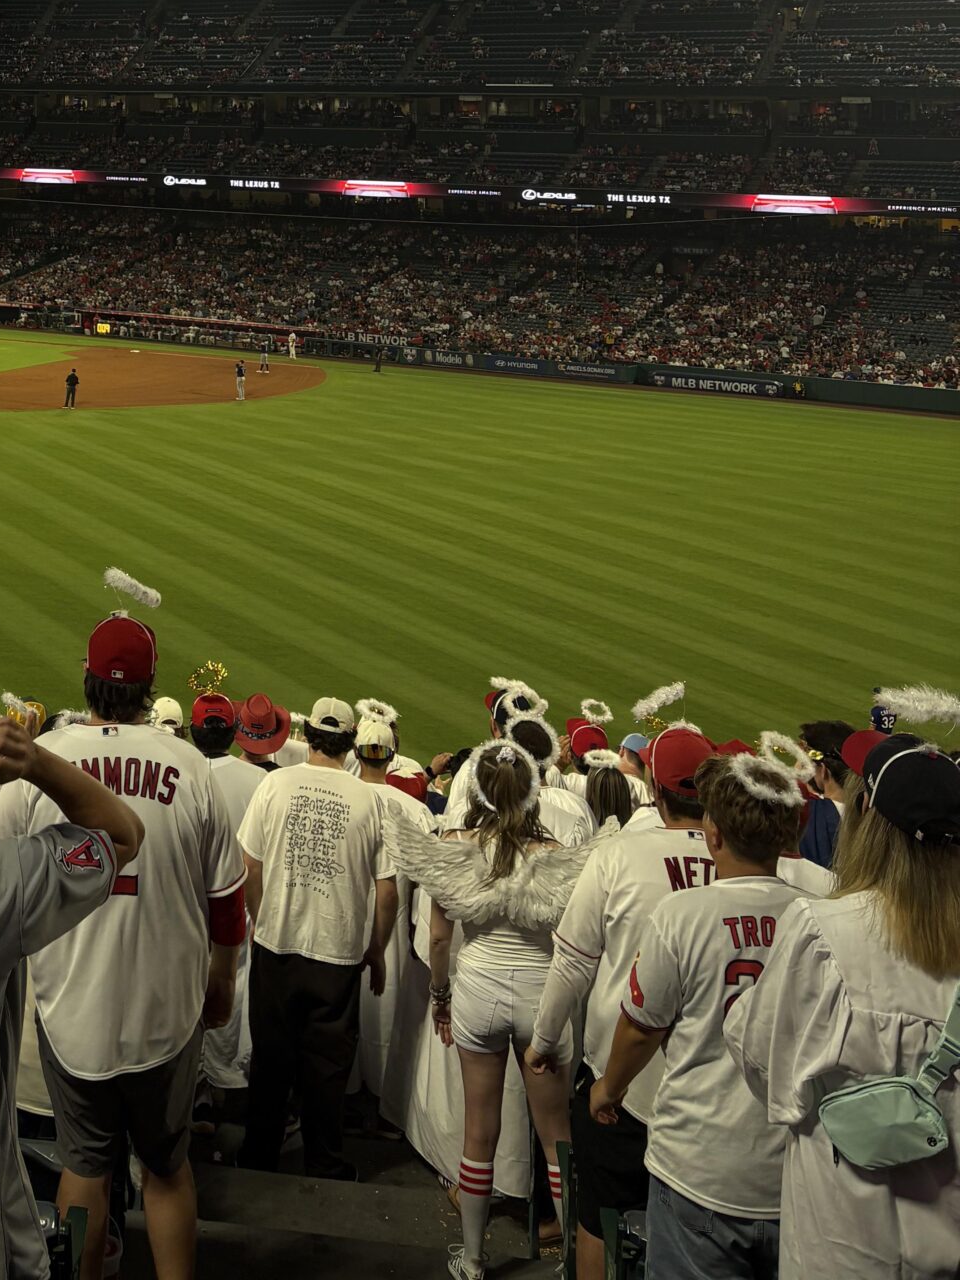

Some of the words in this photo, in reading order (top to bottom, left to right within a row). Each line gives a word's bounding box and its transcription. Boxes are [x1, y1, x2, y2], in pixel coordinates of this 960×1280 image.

[175, 178, 207, 186] LEXUS
[230, 179, 244, 188] THE
[244, 180, 269, 189] LEXUS
[270, 181, 280, 189] TX
[536, 191, 577, 200] LEXUS
[606, 193, 625, 202] THE
[626, 194, 657, 203] LEXUS
[658, 195, 672, 204] TX
[886, 204, 925, 212] EXPERIENCE
[358, 333, 412, 346] NETWOR
[436, 351, 462, 365] Modelo
[507, 361, 538, 370] HYUNDAI
[671, 377, 697, 389] MLB
[698, 379, 758, 394] NETWORK
[881, 716, 895, 729] 32
[664, 856, 719, 892] NET
